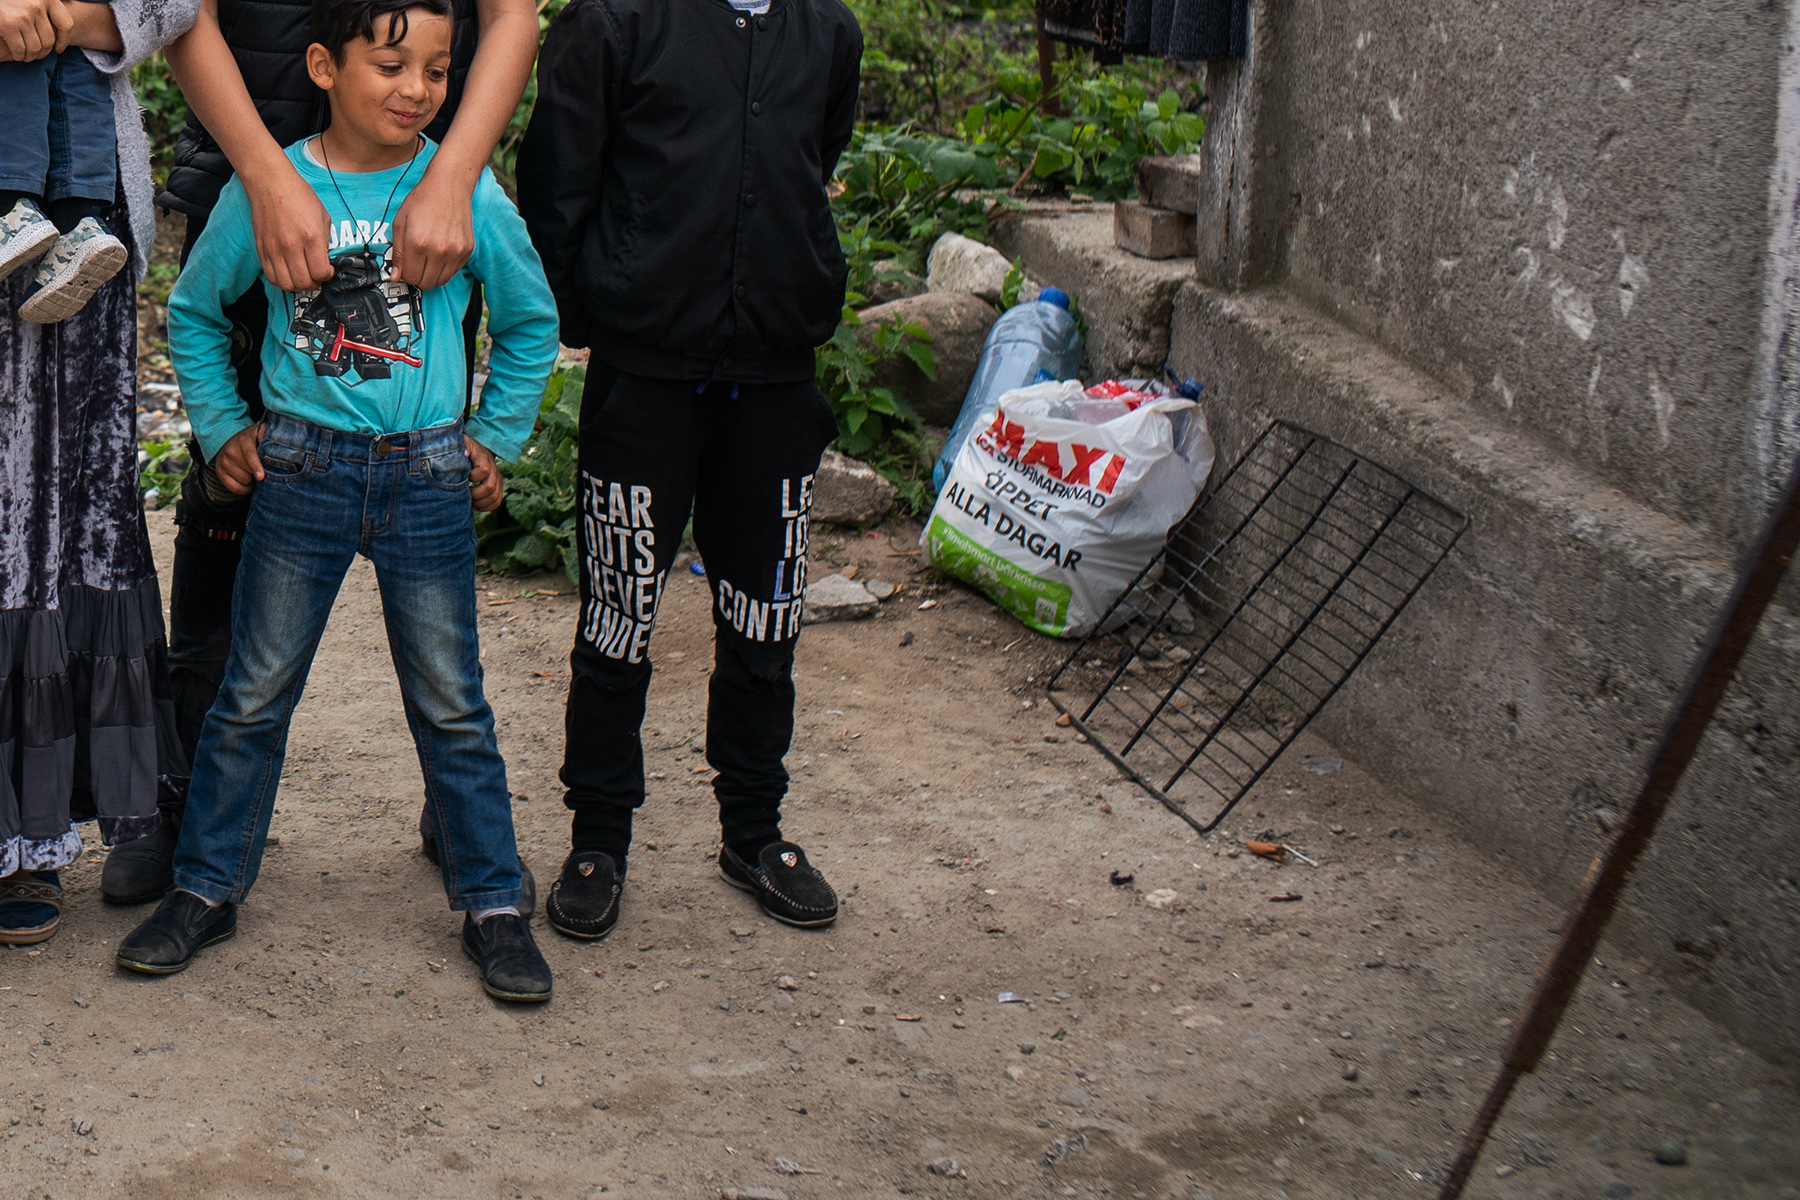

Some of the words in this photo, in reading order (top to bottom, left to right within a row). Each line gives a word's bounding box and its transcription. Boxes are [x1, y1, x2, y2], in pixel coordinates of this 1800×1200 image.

[329, 220, 390, 249] DARK
[976, 433, 995, 457] ICA
[985, 409, 1127, 495] MAXI
[946, 481, 990, 526] ALLA
[994, 513, 1082, 571] DAGAR
[985, 469, 1058, 521] ÖPPET
[584, 513, 654, 575] OUTS
[584, 598, 655, 664] UNDE
